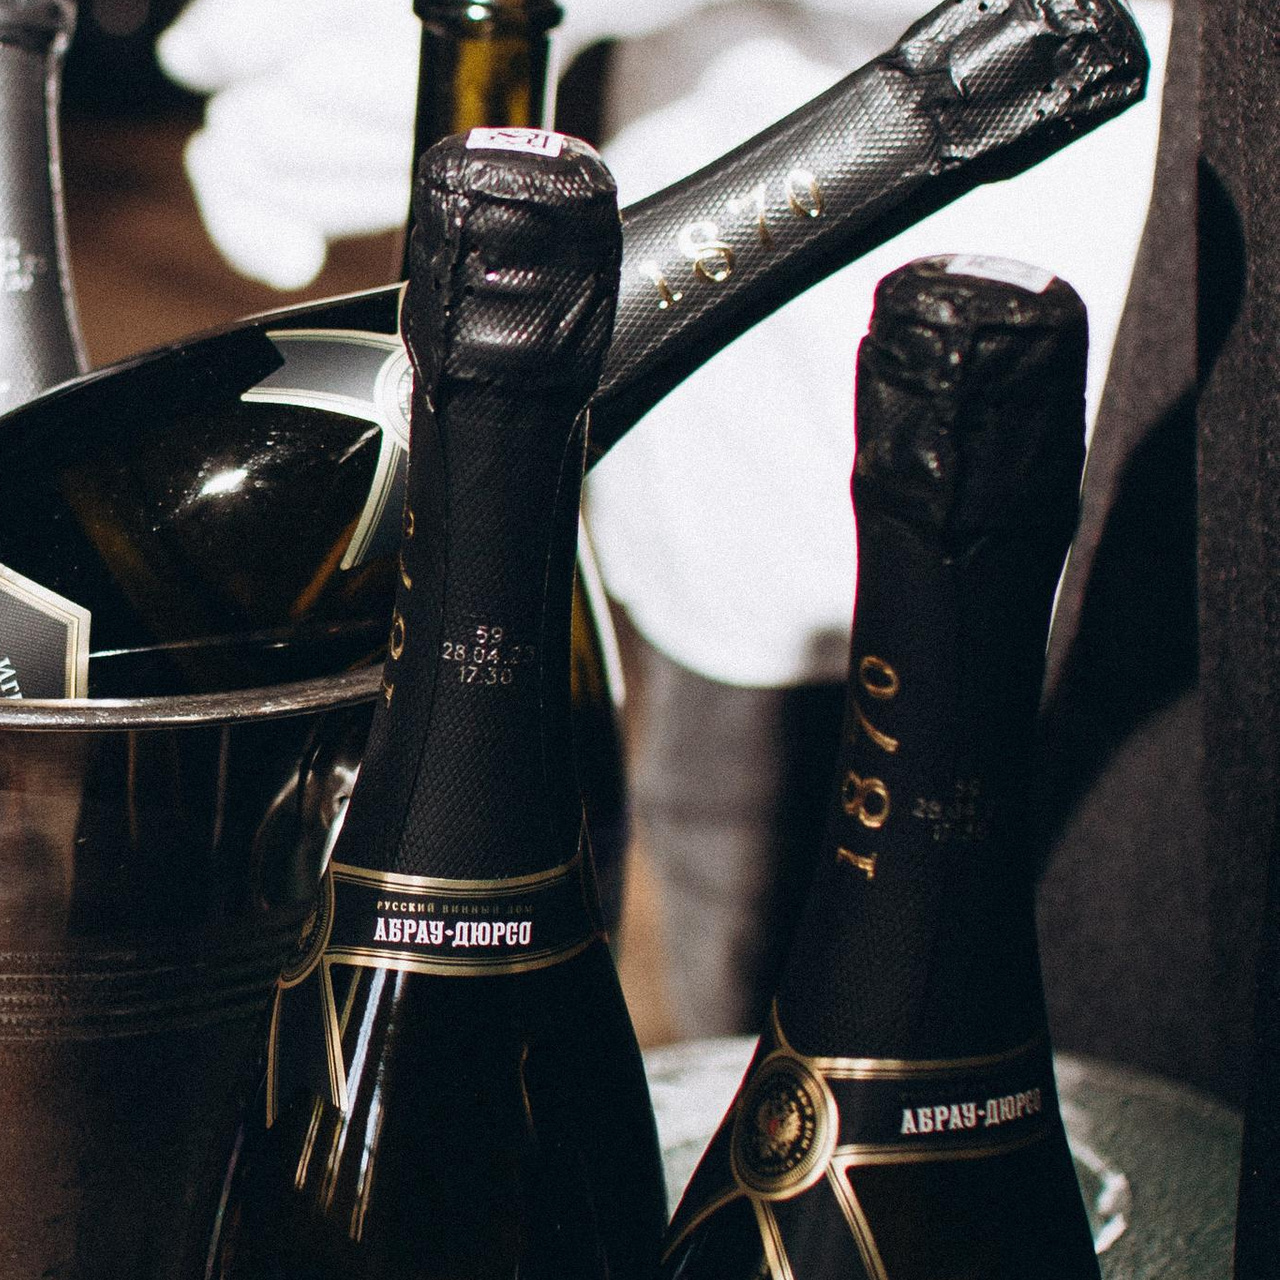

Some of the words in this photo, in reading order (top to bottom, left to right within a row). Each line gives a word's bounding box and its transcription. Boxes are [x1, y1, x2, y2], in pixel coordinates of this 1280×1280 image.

[476, 624, 504, 644] 59
[376, 900, 436, 914] РУССКИЙ
[373, 917, 533, 948] АБРАУ-ДЮРСО
